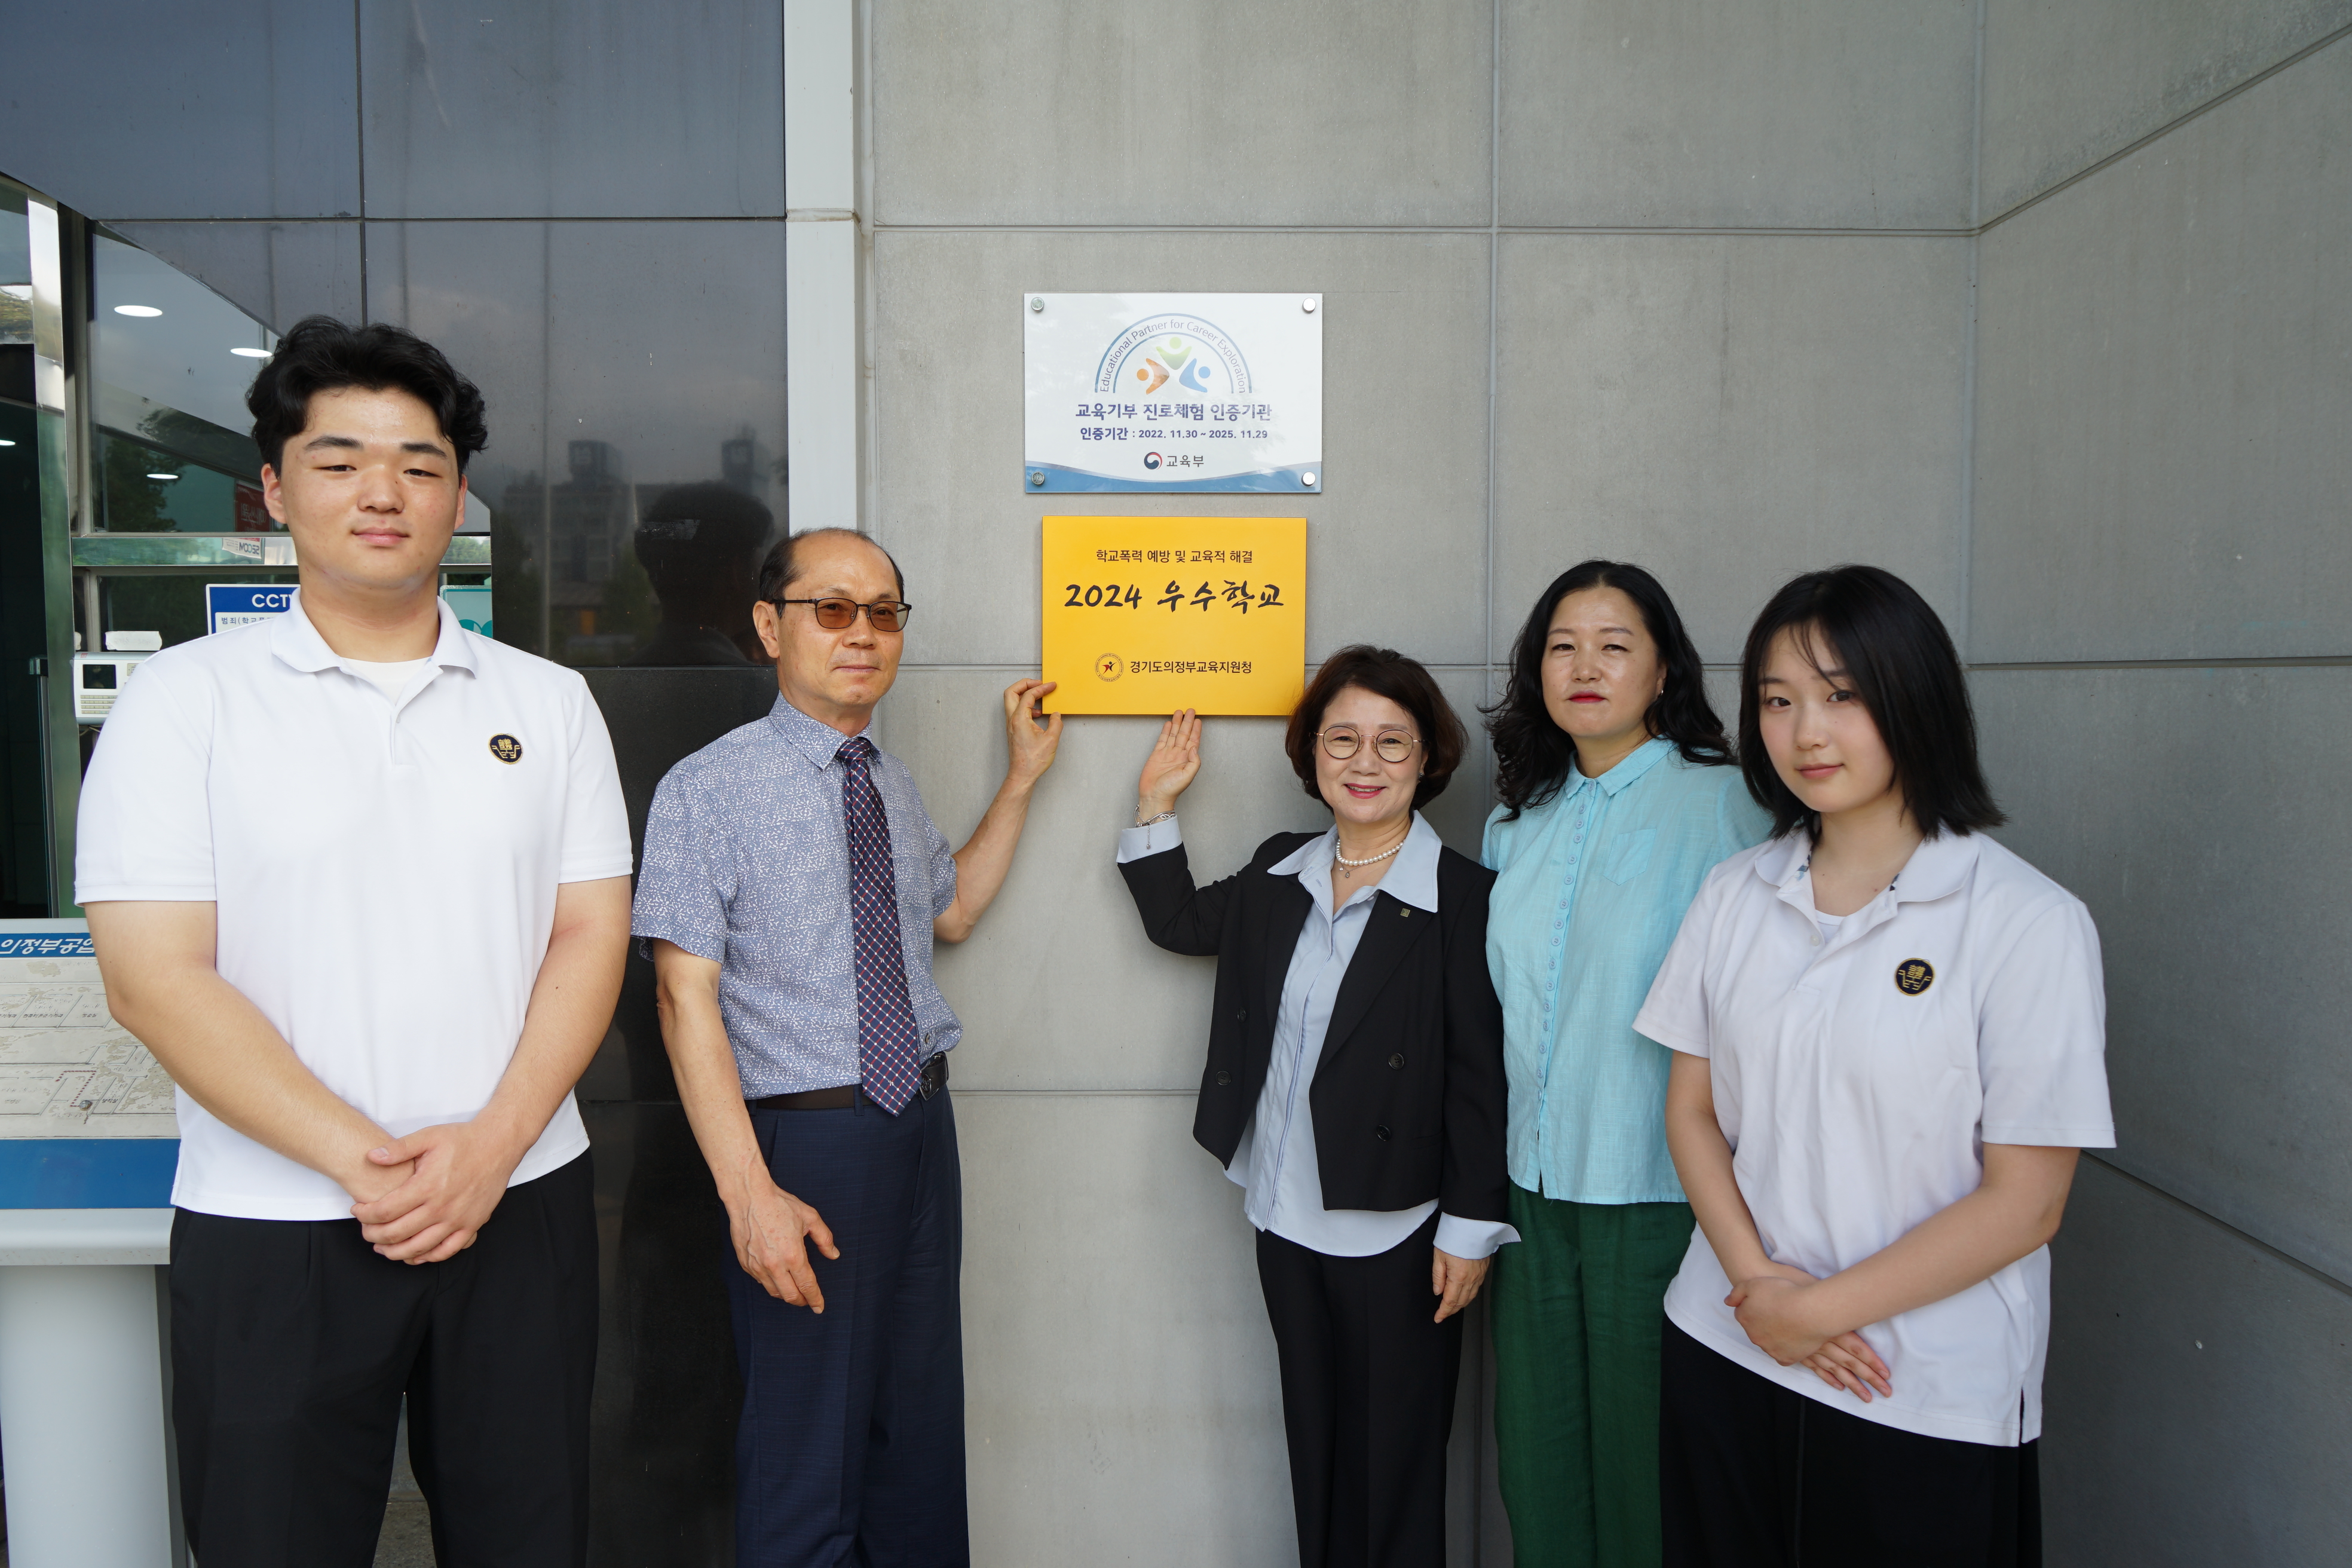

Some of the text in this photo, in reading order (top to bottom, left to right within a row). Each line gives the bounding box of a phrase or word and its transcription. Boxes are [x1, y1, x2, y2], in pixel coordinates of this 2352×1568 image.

[1100, 319, 1247, 393] Educational Partner for Career Exploration
[1076, 403, 1272, 422] 교육기부 진로체험 인증기관
[1080, 427, 1128, 440] 인증기간
[1138, 430, 1166, 439] 2022.
[1170, 430, 1198, 439] 11.30
[1209, 430, 1237, 439] 2025.
[1240, 430, 1268, 439] 11.29
[1166, 455, 1205, 468] 교육부
[1096, 550, 1253, 564] 학교폭력 예방 및 교육적 해결
[252, 593, 291, 608] CCT
[1064, 580, 1284, 614] 2024 우수학교
[1130, 661, 1252, 674] 경기도의정부교육지원청
